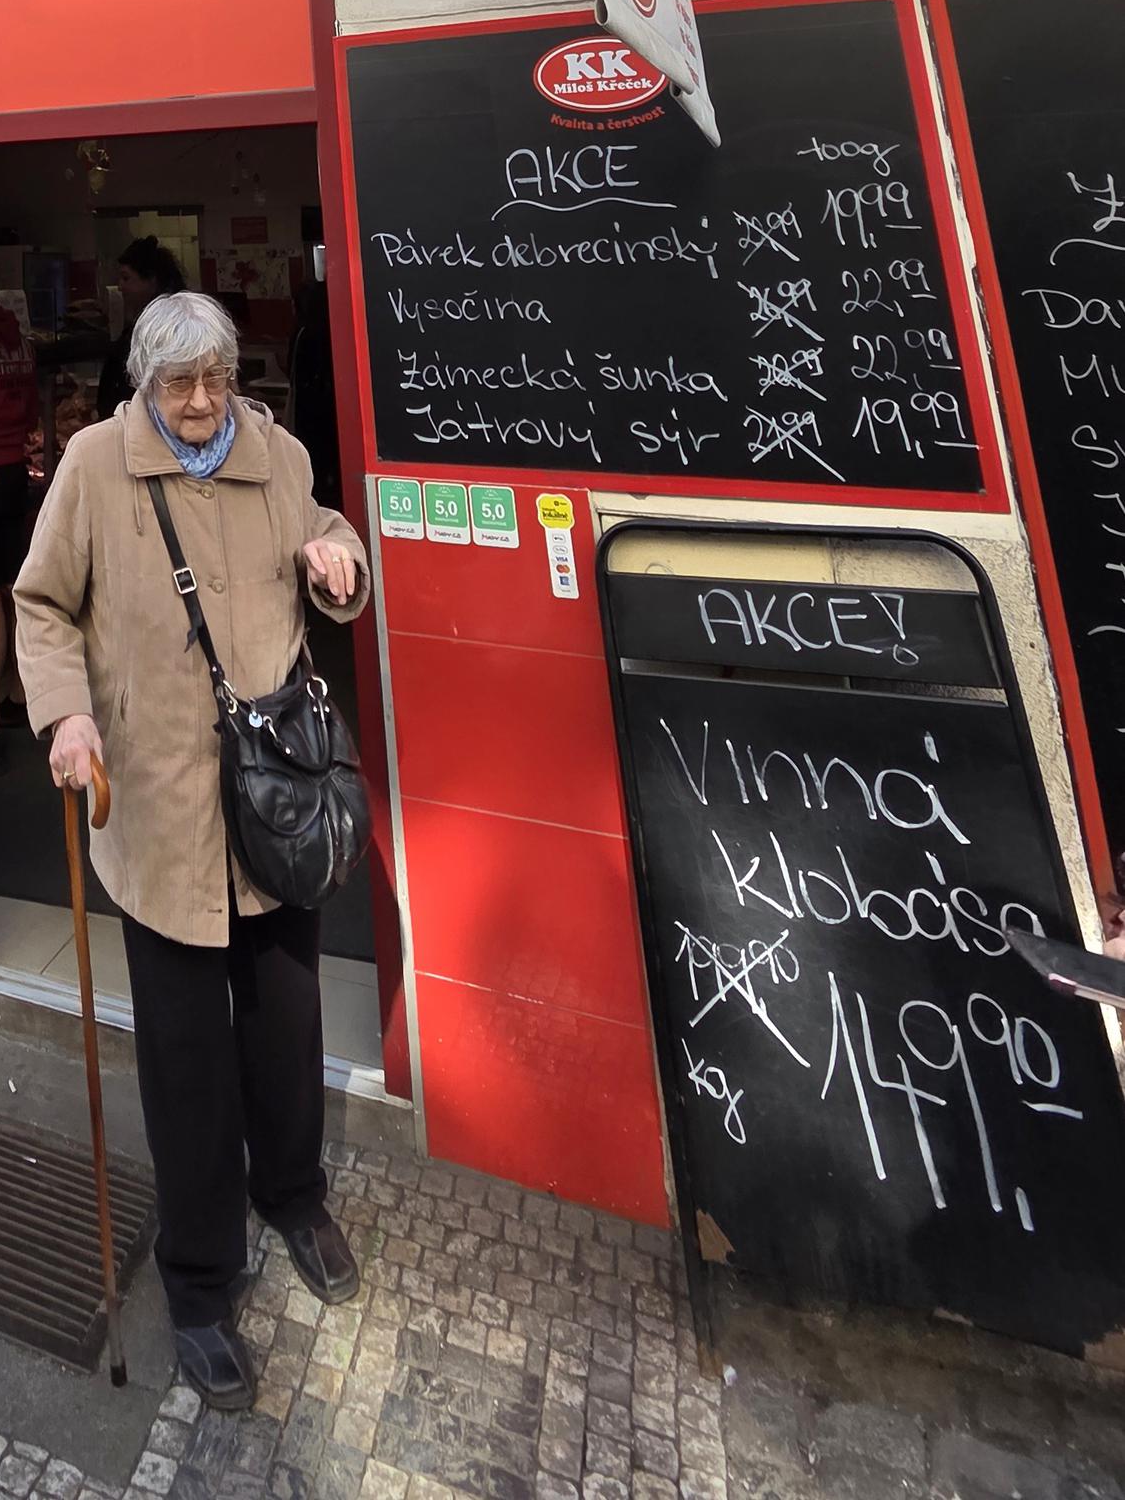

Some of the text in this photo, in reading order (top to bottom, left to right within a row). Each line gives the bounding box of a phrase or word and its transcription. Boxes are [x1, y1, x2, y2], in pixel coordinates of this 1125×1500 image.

[554, 77, 654, 95] Miloš Křeček
[563, 49, 638, 81] KK
[550, 106, 666, 132] Kvalita a čerstvost
[505, 143, 640, 199] AKCE
[370, 228, 486, 268] Párek
[387, 287, 552, 333] Vysočina
[595, 352, 729, 402] šunka
[406, 399, 602, 464] Játrový
[629, 407, 720, 466] sýr
[389, 495, 412, 513] 5,0
[435, 500, 458, 518] 5,0
[481, 503, 506, 520] 5,0
[697, 588, 921, 667] AKCE!
[659, 717, 971, 846] Vinná
[682, 1038, 747, 1145] kg
